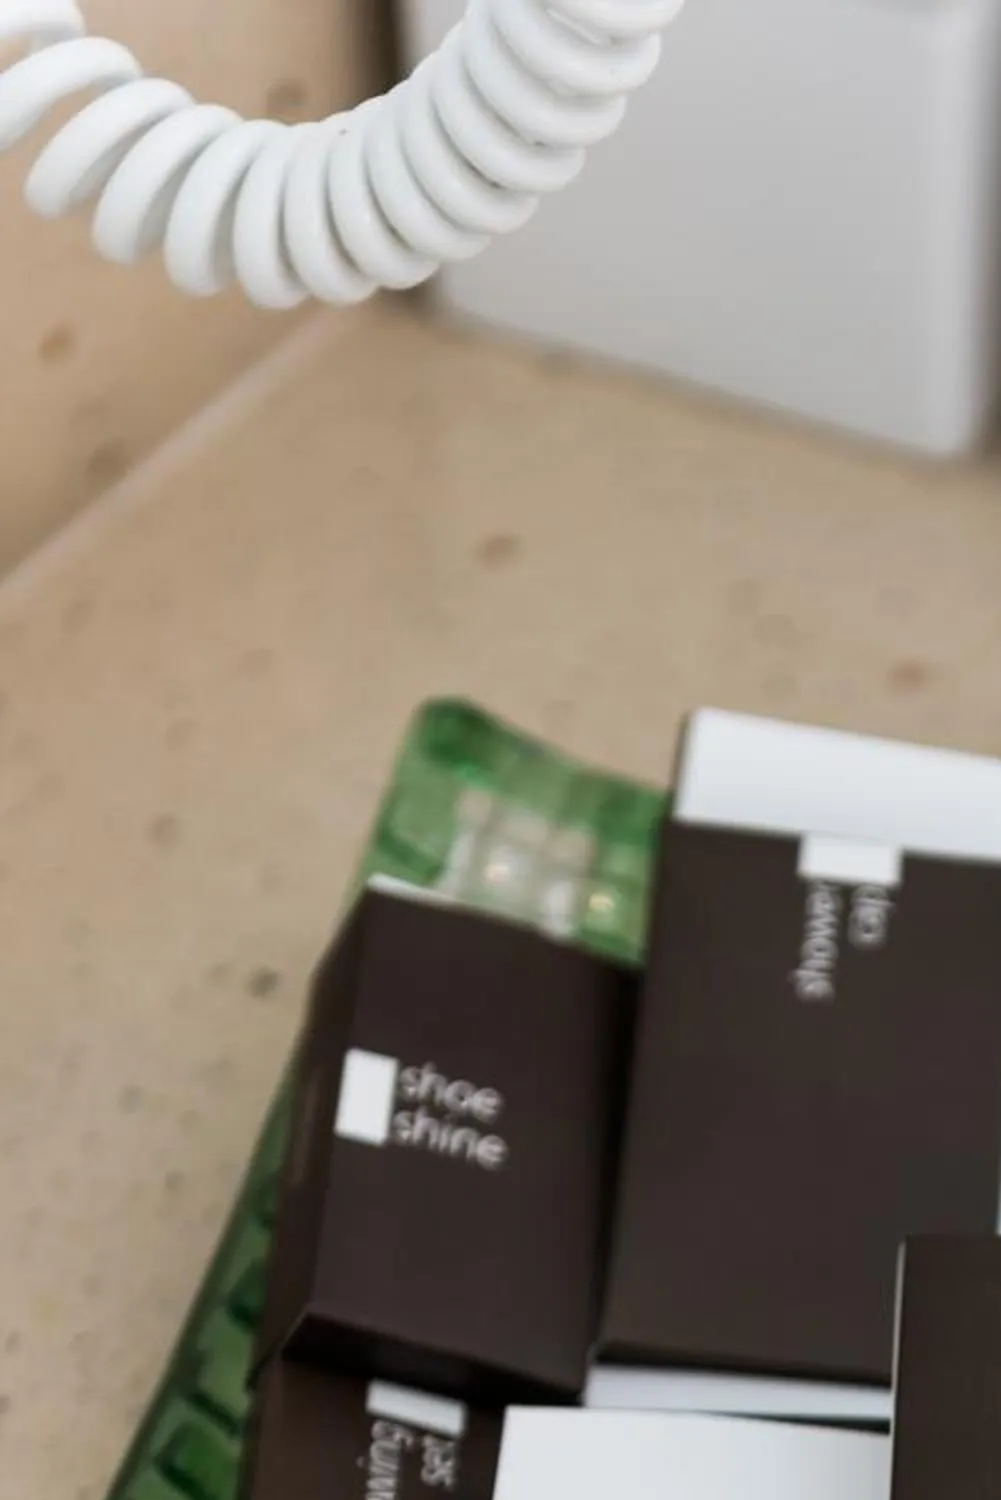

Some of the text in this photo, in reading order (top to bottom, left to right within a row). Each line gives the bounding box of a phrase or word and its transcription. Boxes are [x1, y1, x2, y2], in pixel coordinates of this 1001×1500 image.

[788, 878, 841, 1001] shower
[847, 883, 895, 949] cap
[400, 1061, 504, 1125] shoe
[393, 1105, 509, 1171] shine
[420, 1434, 458, 1490] set
